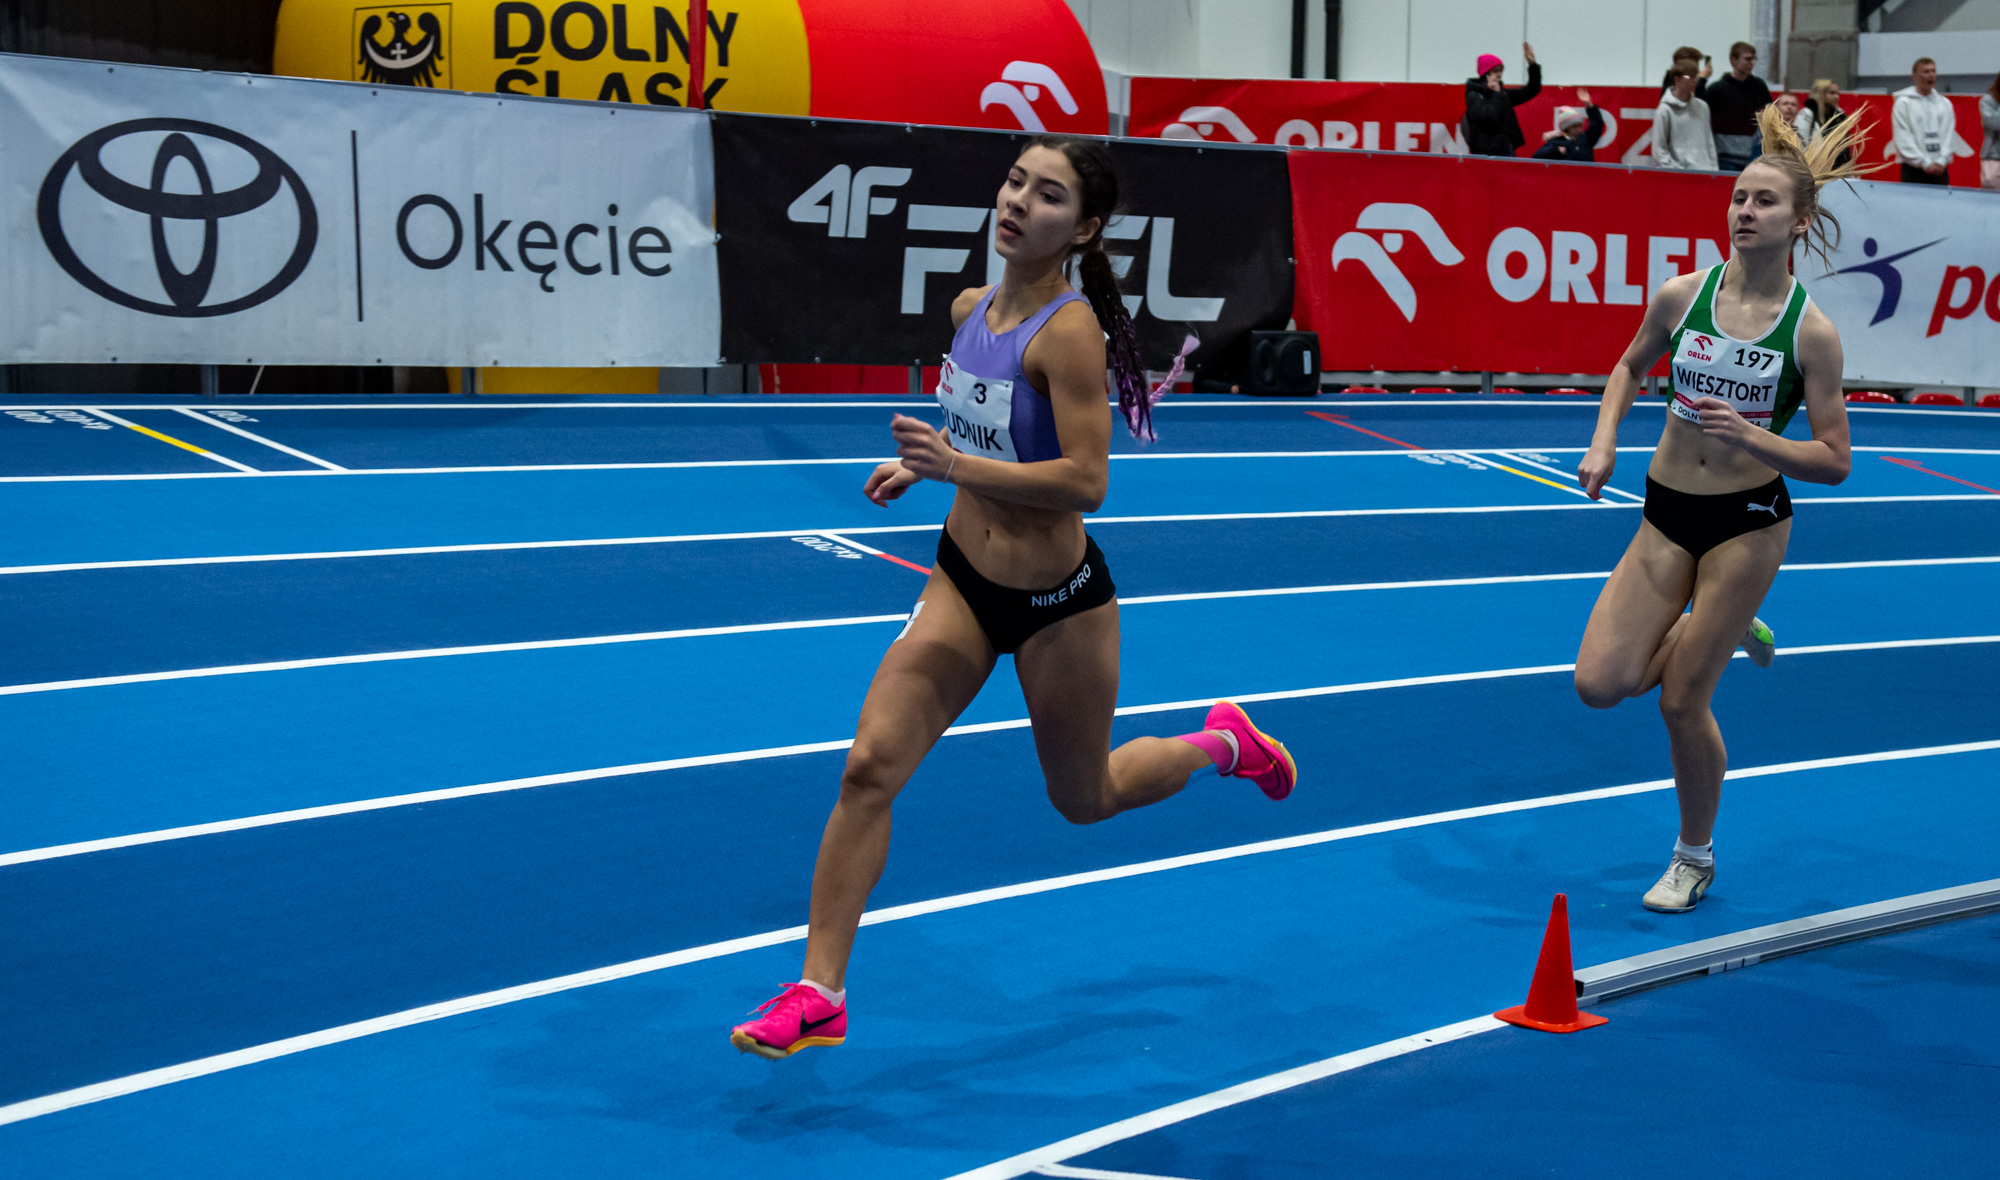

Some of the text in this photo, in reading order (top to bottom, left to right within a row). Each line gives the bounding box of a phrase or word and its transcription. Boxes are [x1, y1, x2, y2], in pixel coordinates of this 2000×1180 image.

[494, 1, 739, 67] DOLNY
[787, 163, 913, 238] 4F
[396, 193, 672, 292] Okęcie
[1687, 350, 1712, 362] ORLEN
[1734, 348, 1775, 371] 197
[973, 382, 988, 405] 3
[1676, 366, 1773, 402] WIESZTORT
[940, 404, 1004, 452] UDNIK
[1031, 563, 1092, 607] NIKE PRO
